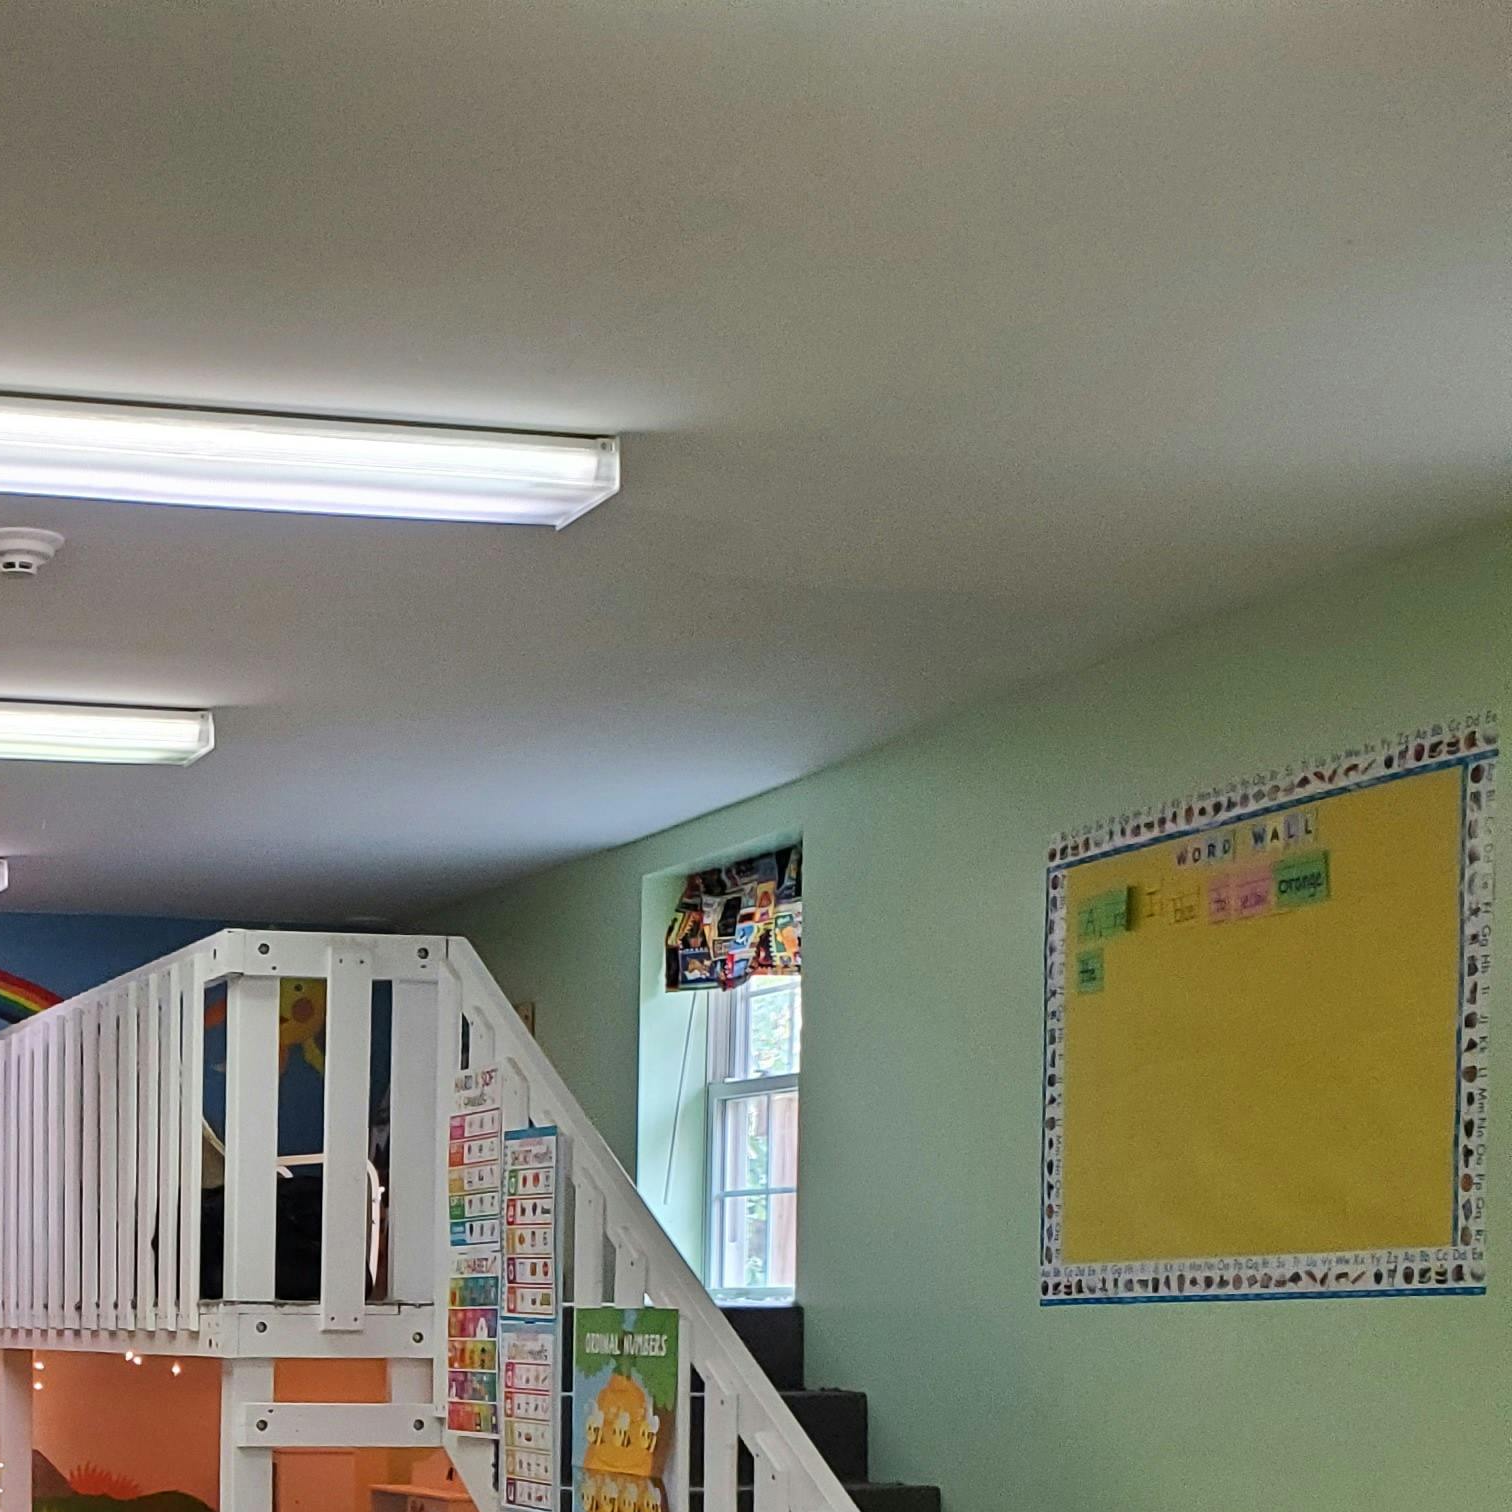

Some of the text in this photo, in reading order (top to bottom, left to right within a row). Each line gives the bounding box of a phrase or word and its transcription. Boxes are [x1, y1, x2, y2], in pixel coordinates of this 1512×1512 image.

[1176, 815, 1313, 866] WORD WALL
[1279, 872, 1322, 897] orange
[586, 1332, 667, 1356] ORDINAL NUMBERS
